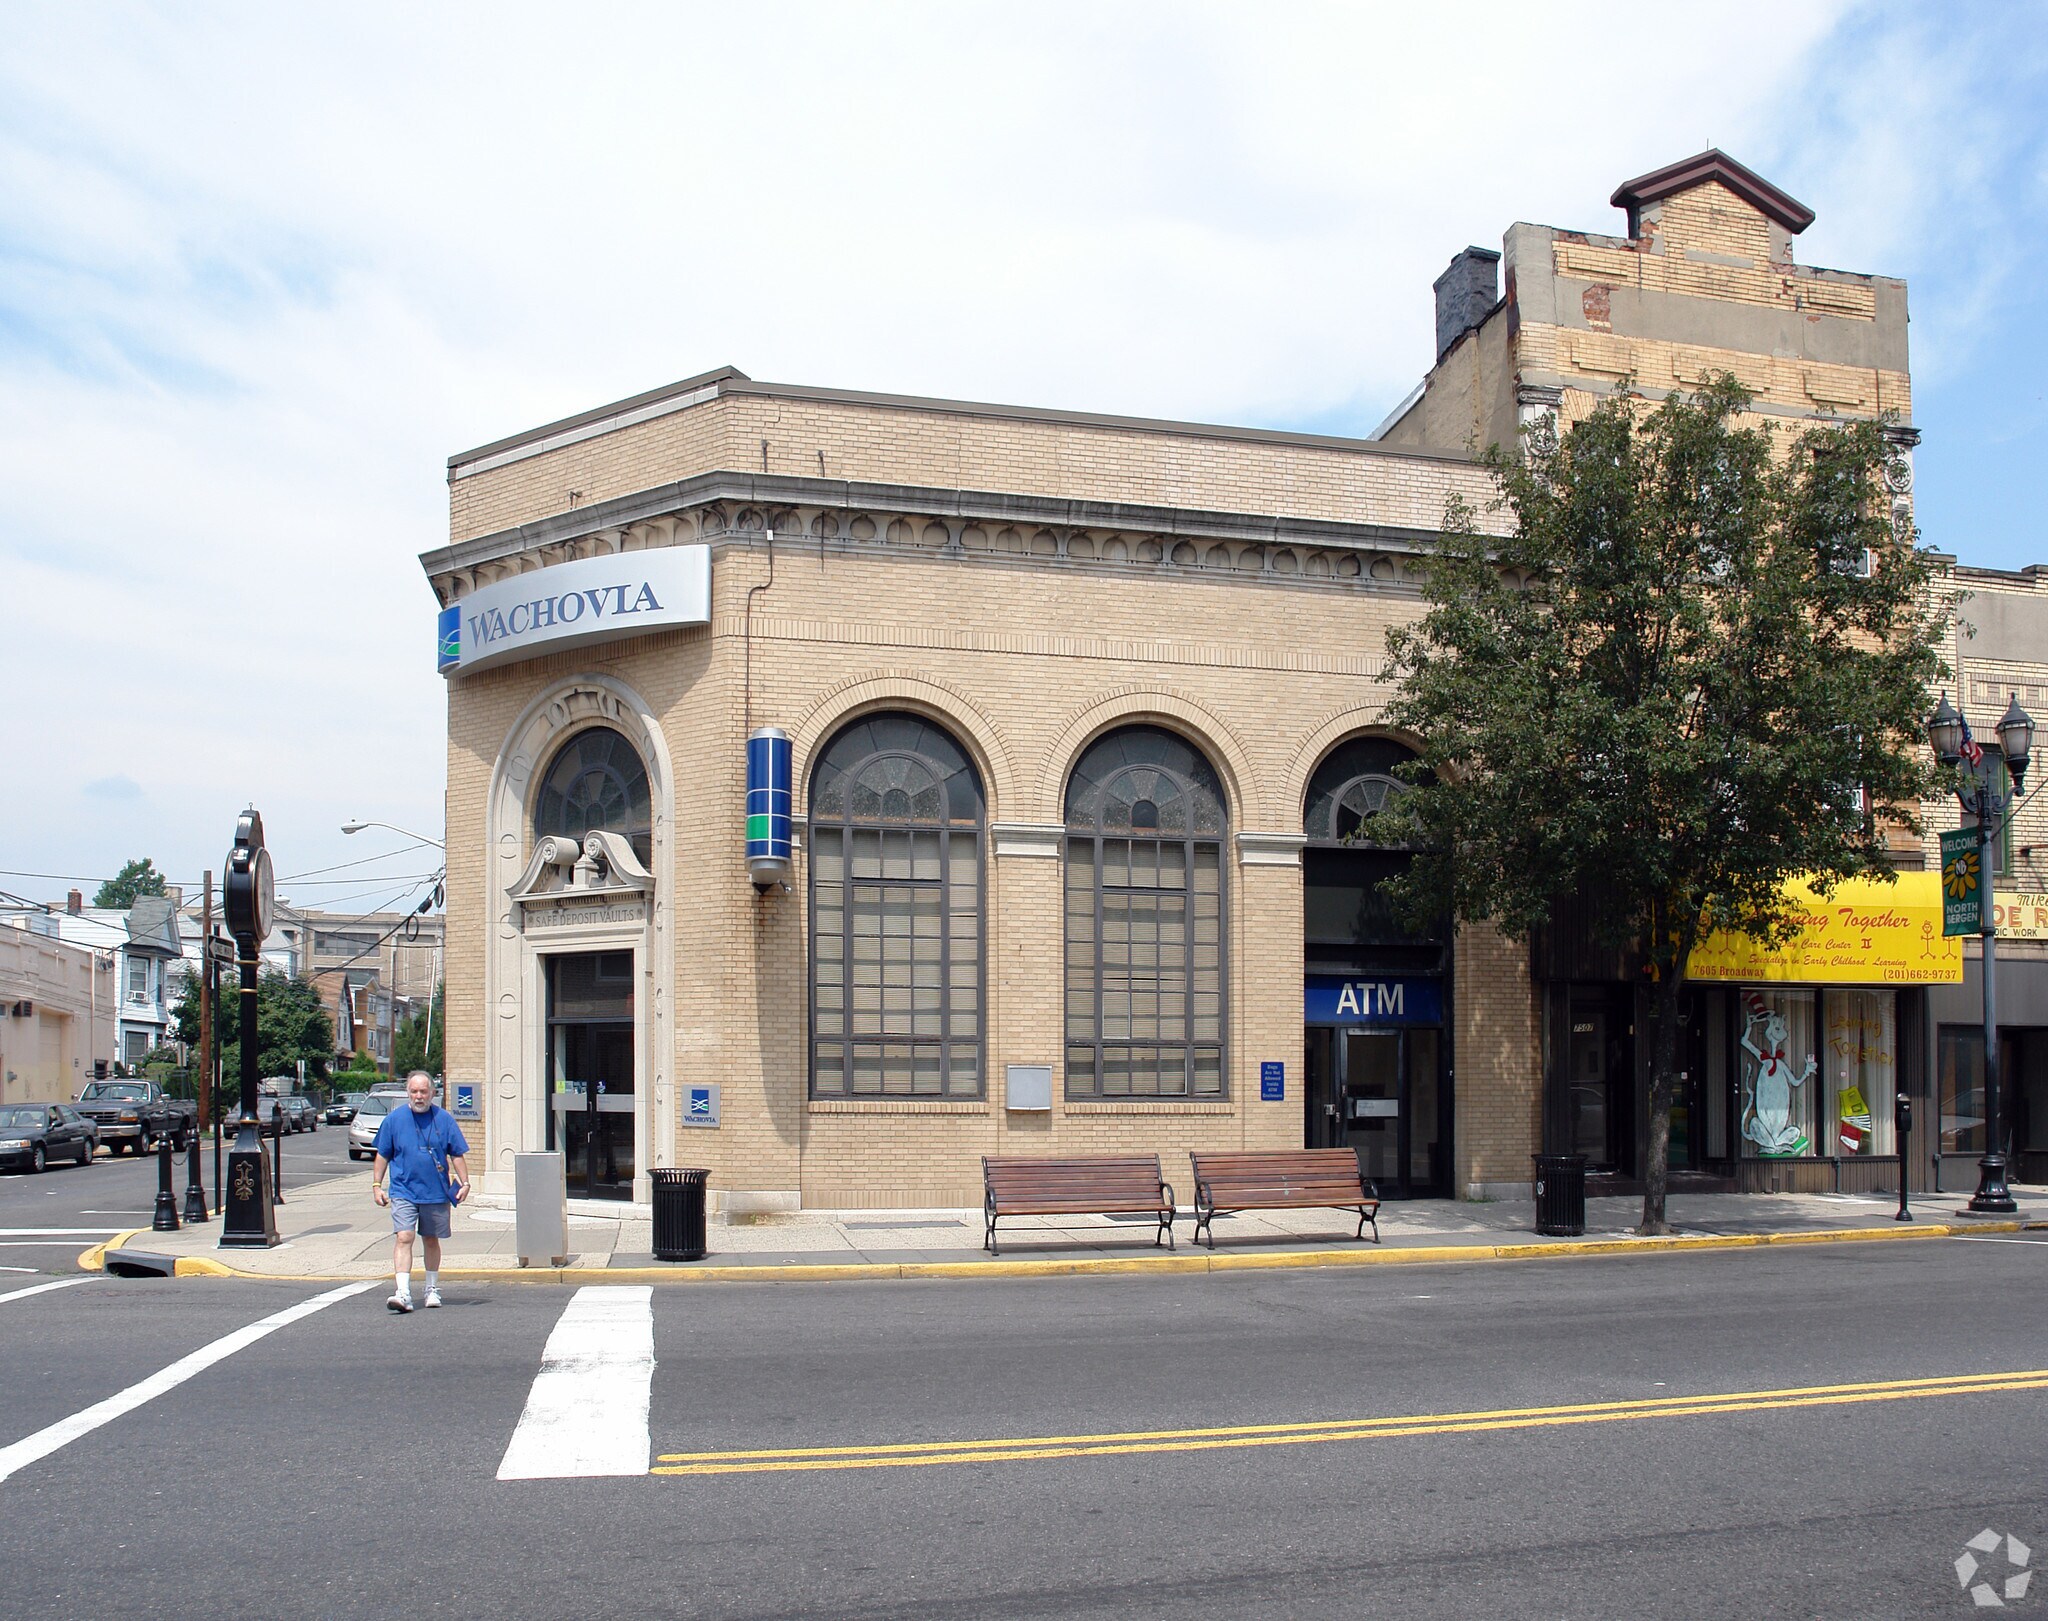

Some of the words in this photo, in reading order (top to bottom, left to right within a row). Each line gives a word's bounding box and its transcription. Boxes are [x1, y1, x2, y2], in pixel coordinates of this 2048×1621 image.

[468, 582, 664, 648] WACHOVIA
[1942, 836, 1978, 852] WELCOME
[1956, 860, 1967, 875] NB
[1946, 902, 1978, 914] NORTH
[535, 915, 557, 928] SAFE
[560, 912, 598, 926] DEPOSIT
[1837, 907, 1911, 933] Together
[1947, 912, 1978, 924] BERGEN
[2012, 928, 2038, 937] WORK
[1801, 938, 1821, 950] Care
[1825, 939, 1852, 950] Center
[1748, 954, 1788, 967] Specialize
[1804, 954, 1828, 966] Early
[1872, 957, 1908, 968] Learning
[1719, 966, 1765, 978] Broadway
[1883, 969, 1957, 980] (201)662-9737
[1336, 983, 1403, 1015] ATM
[1829, 1004, 1882, 1038] Learning
[684, 1115, 716, 1123] WACHOVIA
